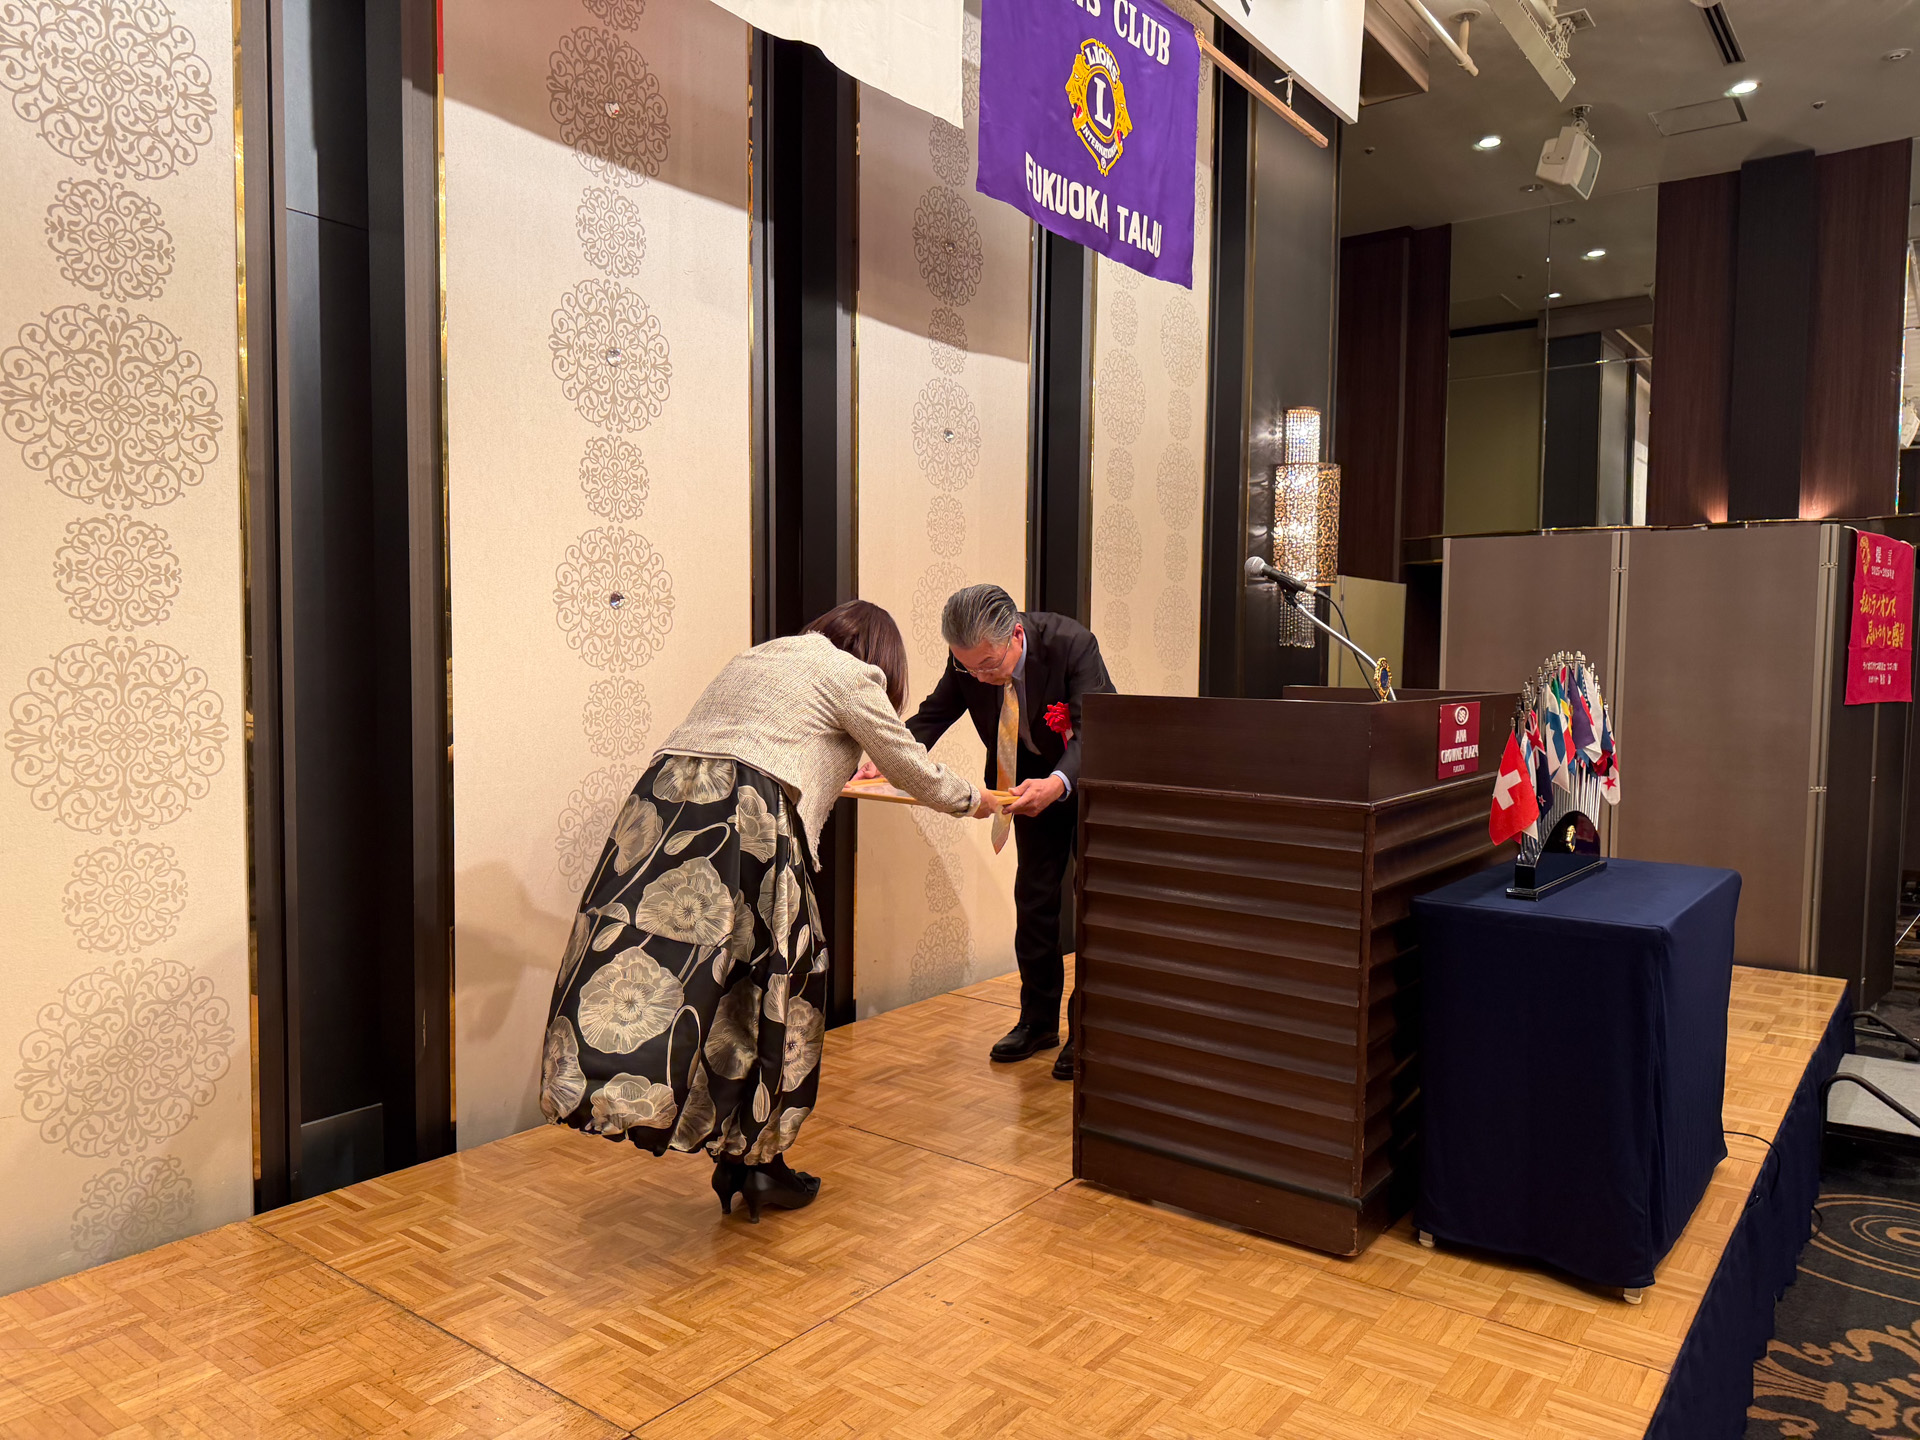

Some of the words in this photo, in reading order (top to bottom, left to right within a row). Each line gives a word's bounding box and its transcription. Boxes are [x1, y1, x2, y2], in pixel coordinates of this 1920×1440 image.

[1114, 0, 1170, 65] CLUB
[1085, 46, 1118, 84] LIONS
[1094, 77, 1112, 129] L
[1025, 151, 1109, 234] FUKUOKA
[1117, 205, 1162, 258] TAIJU
[1441, 747, 1463, 764] CROWNE
[1463, 744, 1479, 760] PLAZA
[1455, 729, 1467, 743] ANA
